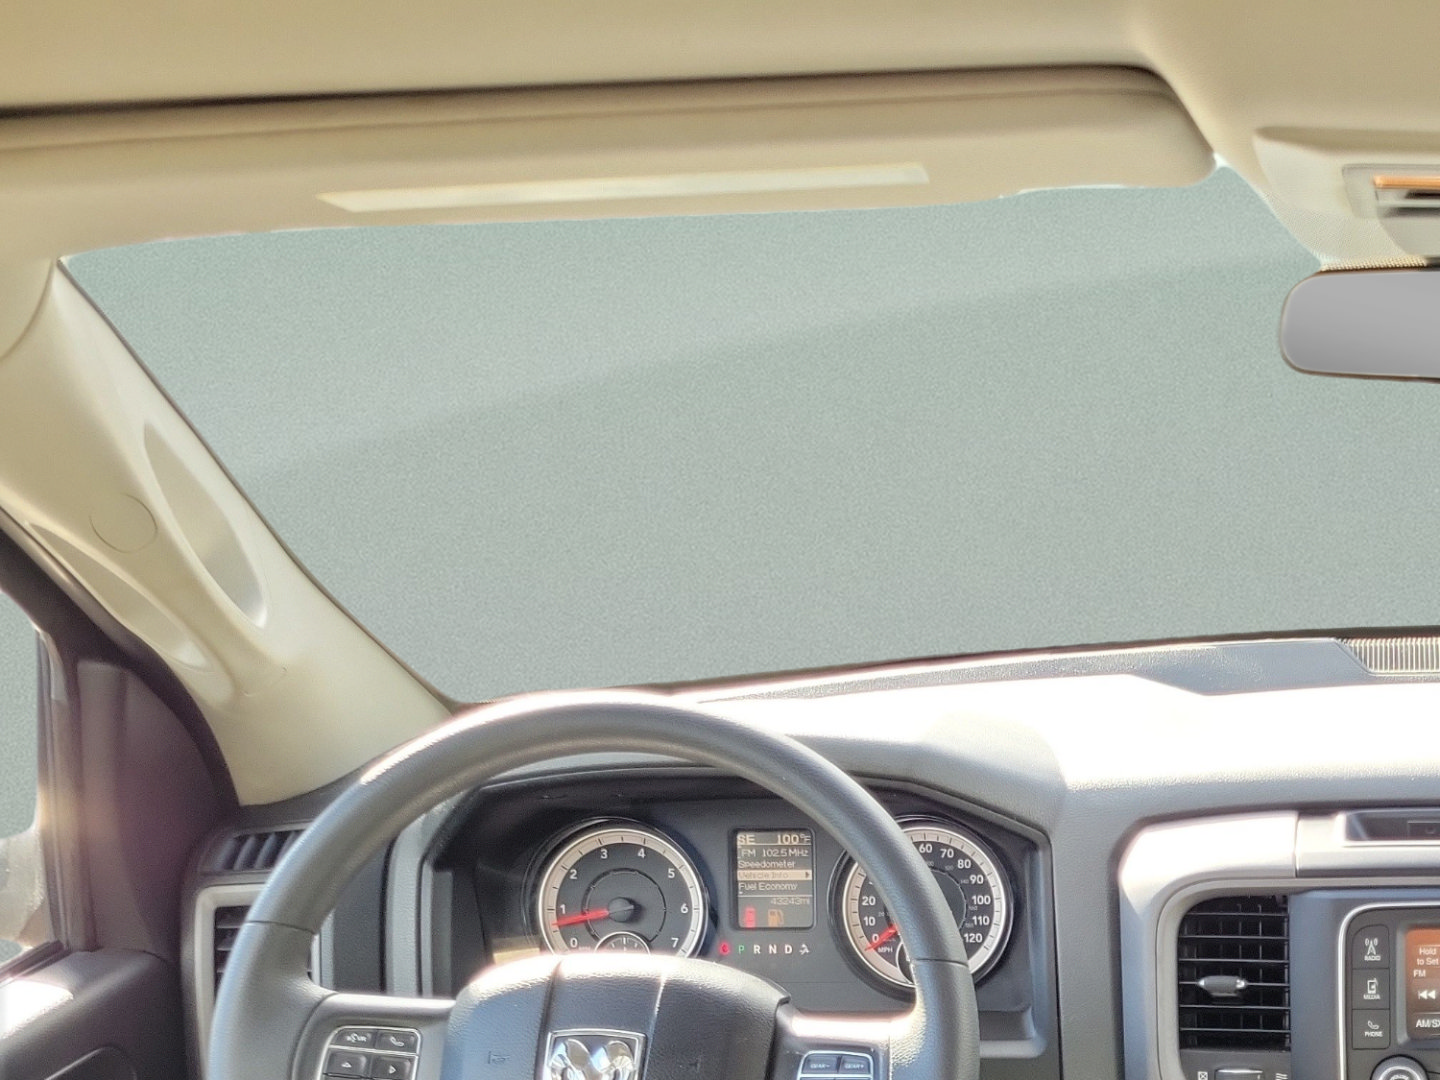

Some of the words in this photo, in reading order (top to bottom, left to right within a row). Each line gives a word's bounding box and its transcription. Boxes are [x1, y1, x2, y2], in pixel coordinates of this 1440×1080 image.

[741, 849, 756, 857] FM
[919, 843, 932, 853] 60
[940, 848, 954, 858] 70
[601, 849, 608, 859] 3
[637, 848, 646, 859] 4
[739, 860, 795, 869] Speedometer
[957, 859, 971, 869] 80
[569, 869, 578, 880] 2
[668, 868, 676, 879] 5
[969, 874, 984, 884] 90
[739, 882, 757, 891] Fuel
[760, 882, 798, 891] Economy
[862, 896, 876, 906] 20
[971, 895, 991, 905] 100
[560, 904, 566, 914] 1
[680, 903, 689, 913] 6
[863, 916, 876, 926] 10
[972, 915, 990, 926] 110
[569, 938, 578, 947] 0
[671, 938, 679, 948] 7
[871, 934, 879, 942] 0
[964, 933, 983, 943] 120
[739, 945, 744, 954] P
[753, 944, 761, 954] R
[769, 944, 777, 954] N
[784, 944, 793, 954] D
[1419, 947, 1436, 956] Hold
[1417, 958, 1425, 966] to
[1427, 957, 1440, 966] Set
[1413, 969, 1426, 977] FM
